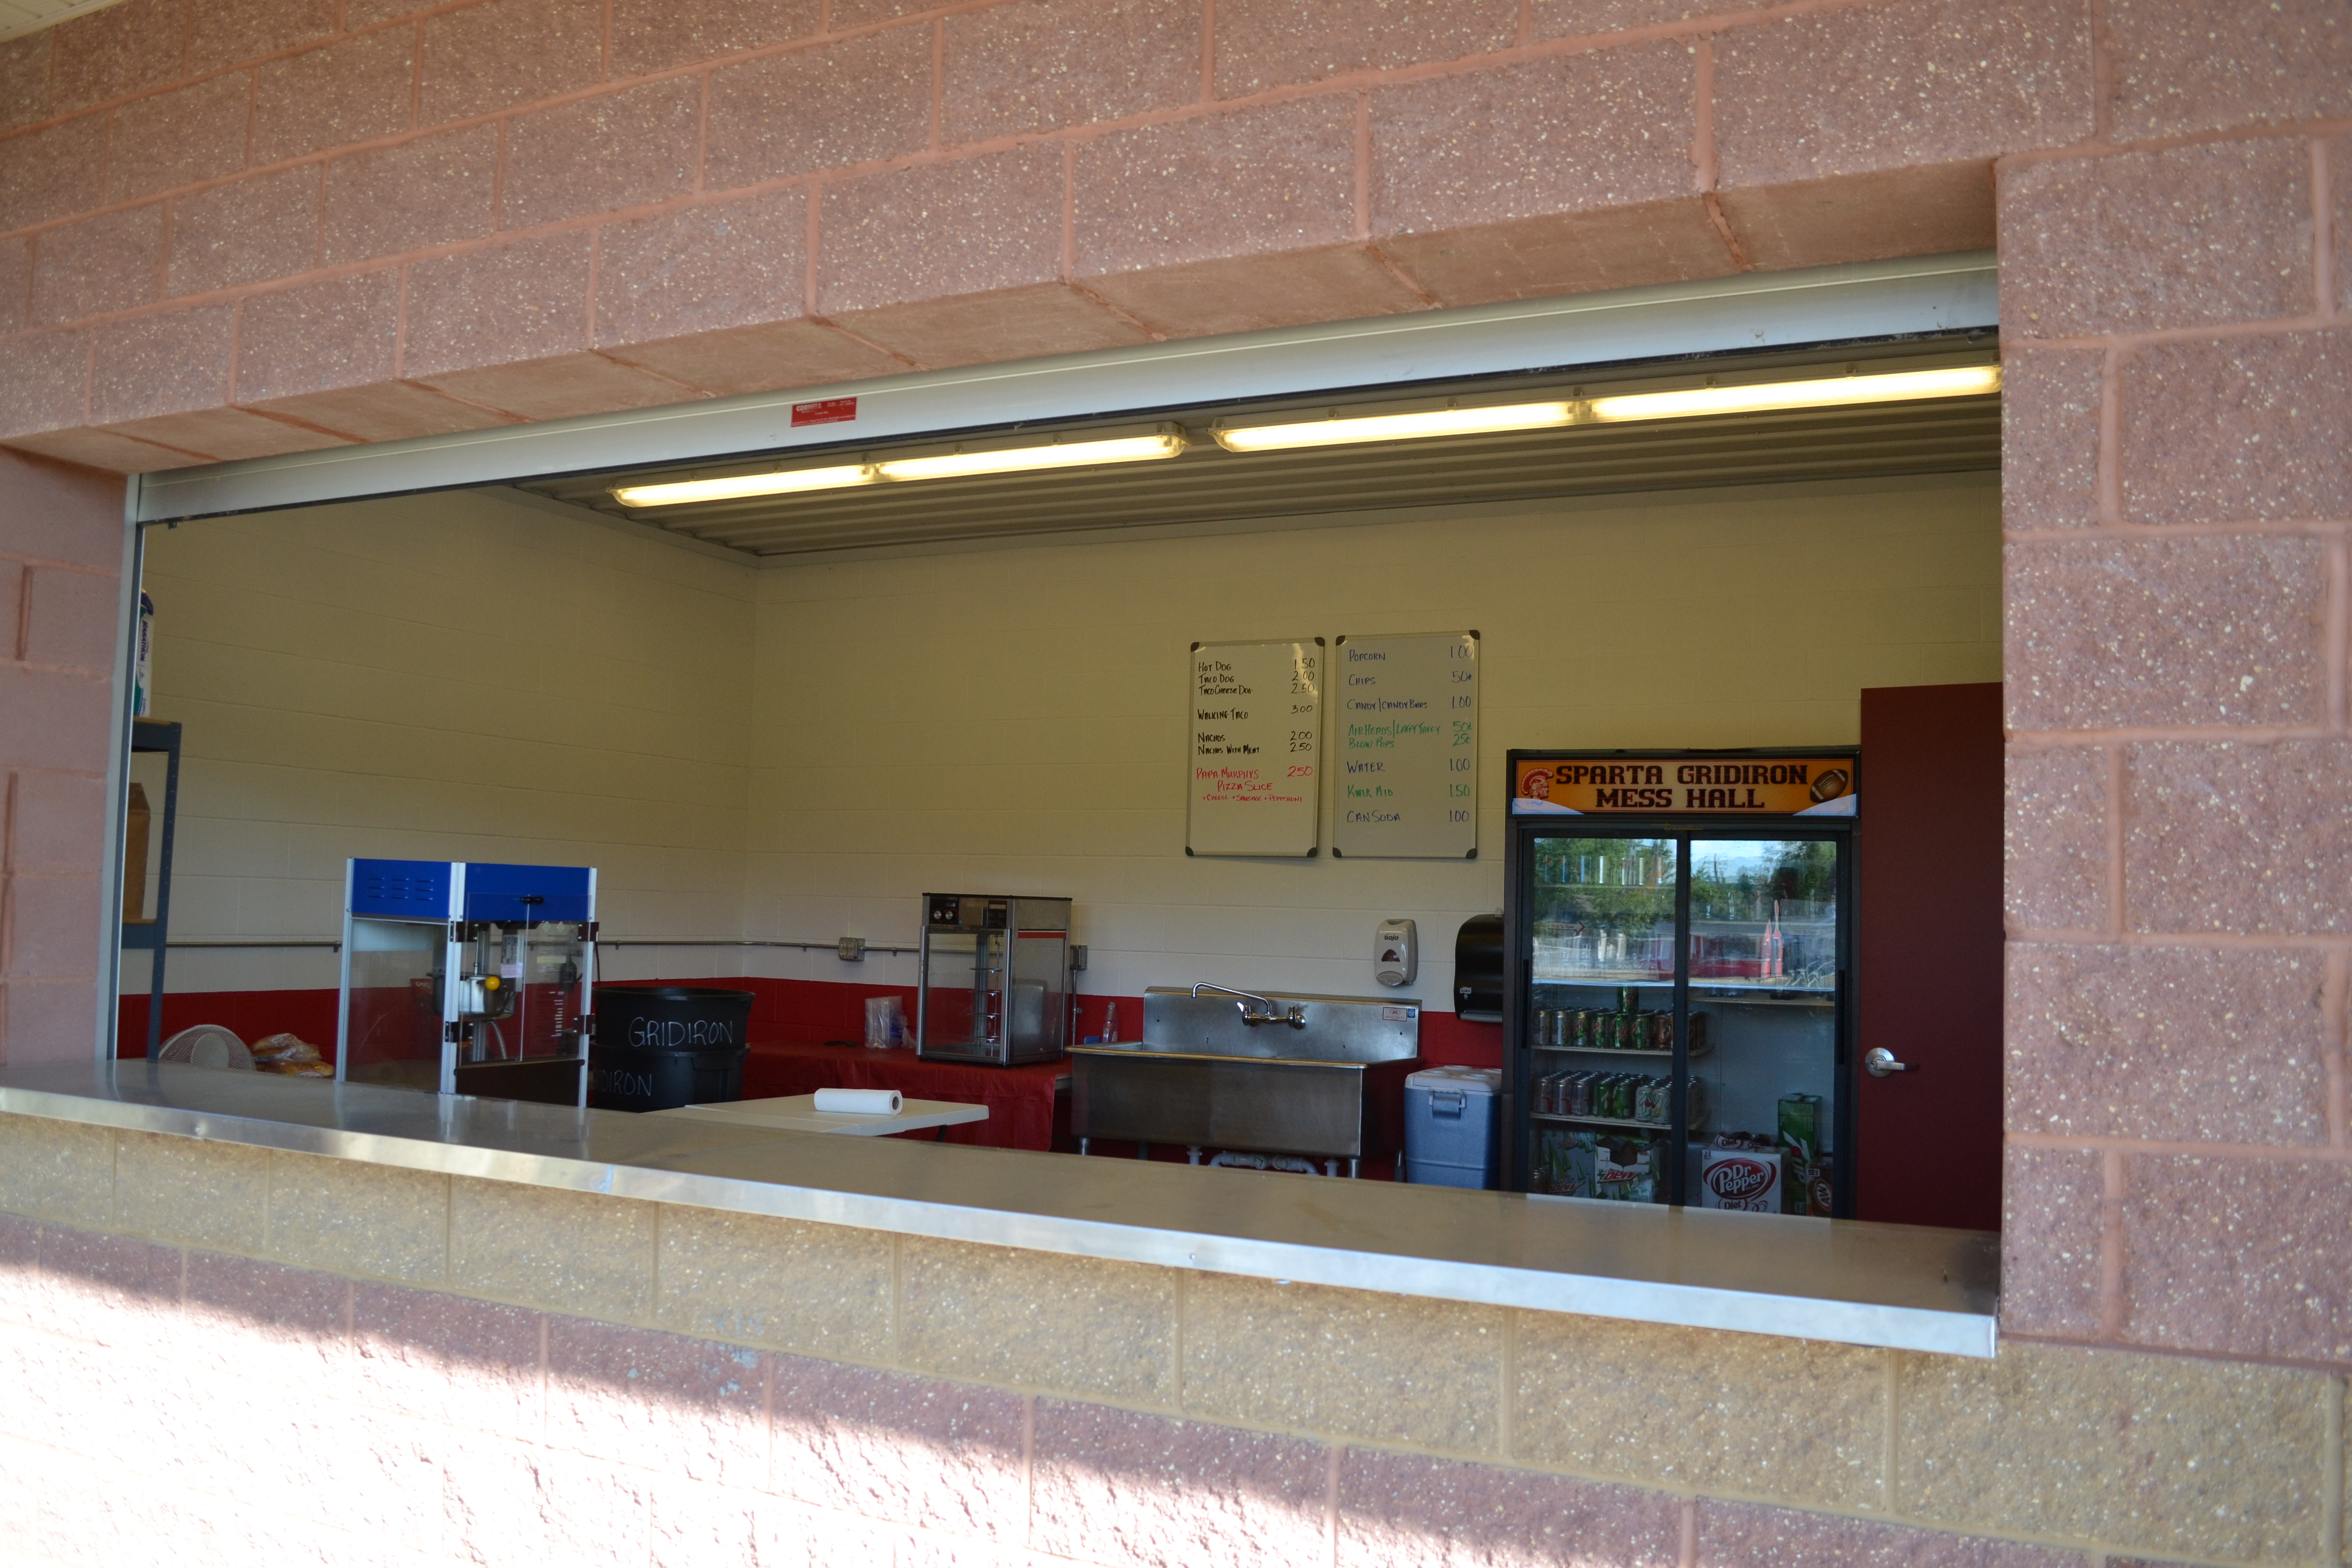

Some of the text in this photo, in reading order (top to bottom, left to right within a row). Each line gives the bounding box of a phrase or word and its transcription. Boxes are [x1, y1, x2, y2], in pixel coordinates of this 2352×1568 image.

[1349, 649, 1386, 662] POPCORN
[1198, 661, 1231, 672] HOT DOG
[1294, 658, 1315, 669] 1.50
[1198, 673, 1234, 684] TACO DOG
[1291, 671, 1314, 681] 2.00
[1349, 674, 1376, 685] CHIPS
[1291, 683, 1314, 694] 2.50
[1452, 696, 1471, 709] 1.00
[1197, 707, 1248, 720] WALKING TACO
[1291, 705, 1312, 714] 3.00
[1198, 732, 1225, 743] NACHOS
[1349, 737, 1394, 748] BLOW POPS
[1198, 744, 1259, 755] NACHOS WITH MEAT
[1346, 760, 1385, 773] WATER
[1196, 767, 1259, 779] PAPA MURPHYS
[1556, 765, 1808, 785] SPARTA GRIDIRON
[1217, 780, 1273, 792] PIZZA SLICE
[1376, 785, 1393, 797] AID
[1596, 788, 1765, 808] MESS HALL
[1347, 810, 1400, 823] CAN SODA
[628, 1017, 732, 1047] GRIDIRON
[1732, 1164, 1751, 1180] Dr
[1717, 1167, 1764, 1194] Pepper
